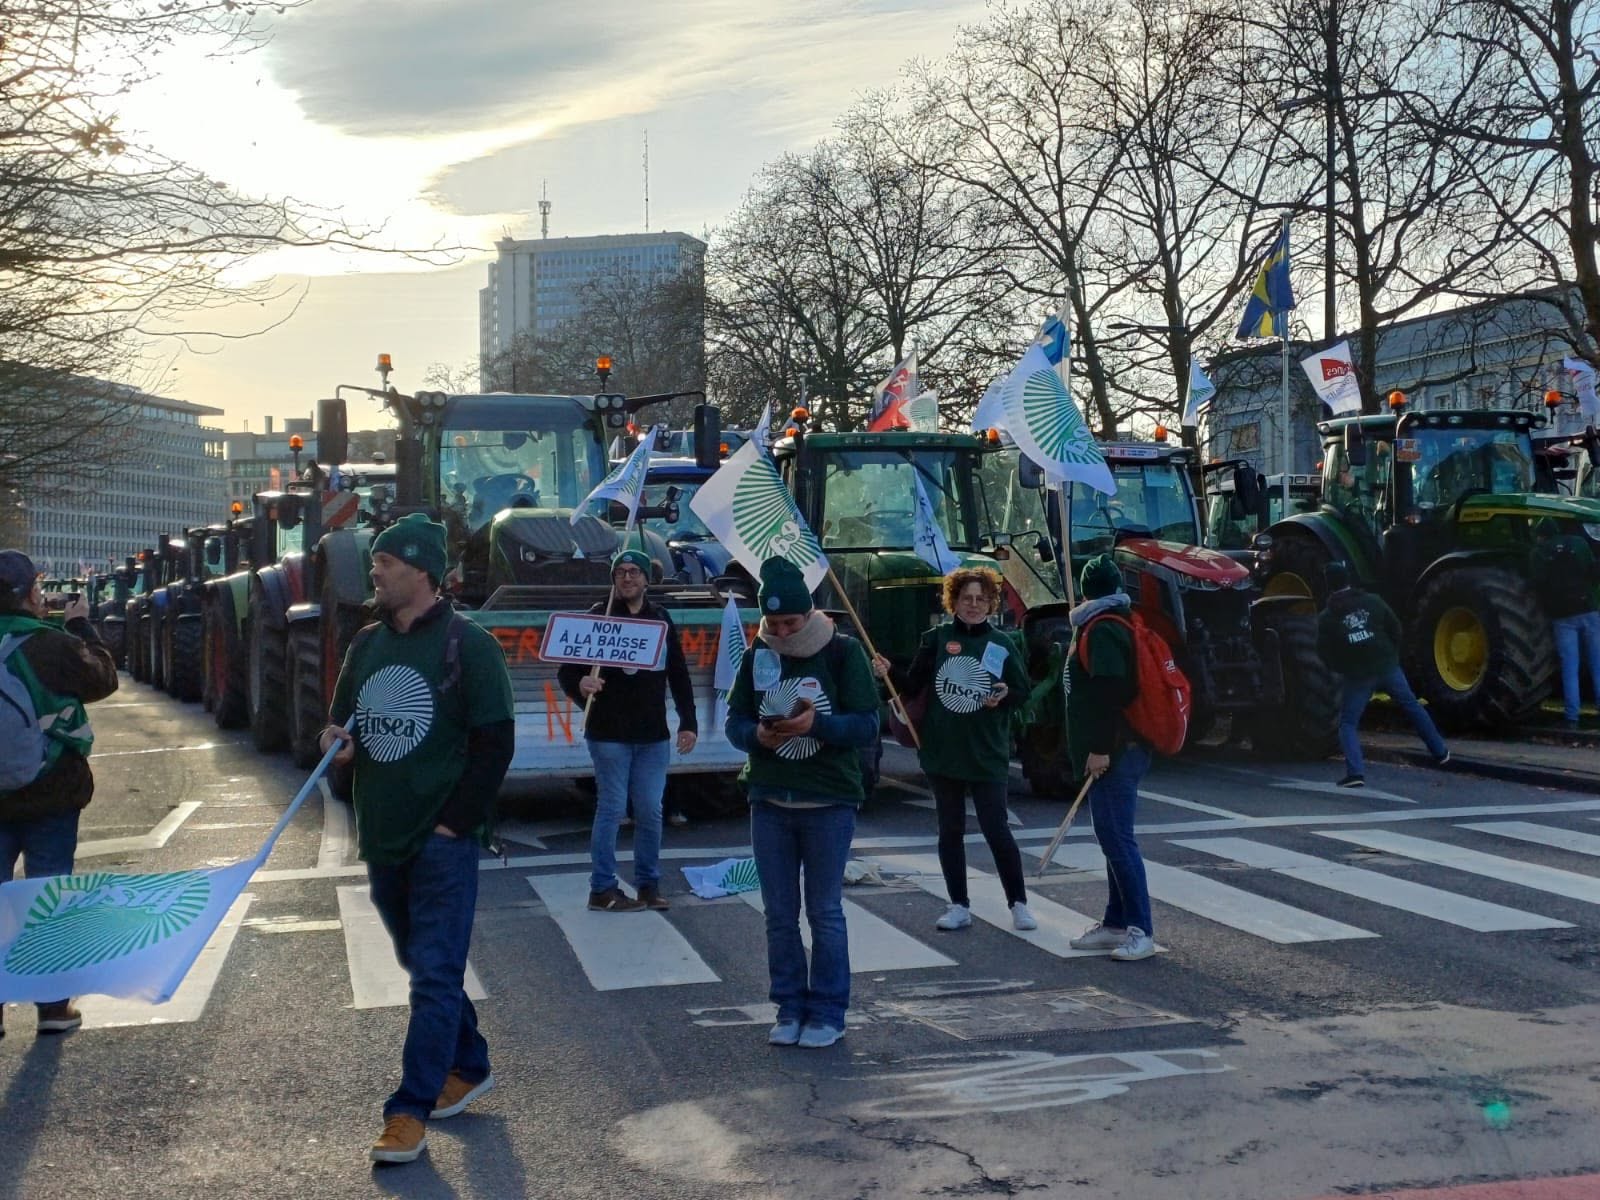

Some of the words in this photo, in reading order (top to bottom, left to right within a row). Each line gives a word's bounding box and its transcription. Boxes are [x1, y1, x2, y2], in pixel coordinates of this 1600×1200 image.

[592, 622, 622, 634] NON
[559, 630, 569, 644] À
[575, 633, 592, 645] LA
[597, 635, 648, 650] BAISSE
[563, 645, 582, 657] DE
[587, 647, 604, 659] LA
[610, 649, 637, 661] PAC
[943, 677, 981, 700] fnsea
[364, 707, 416, 738] fnsea
